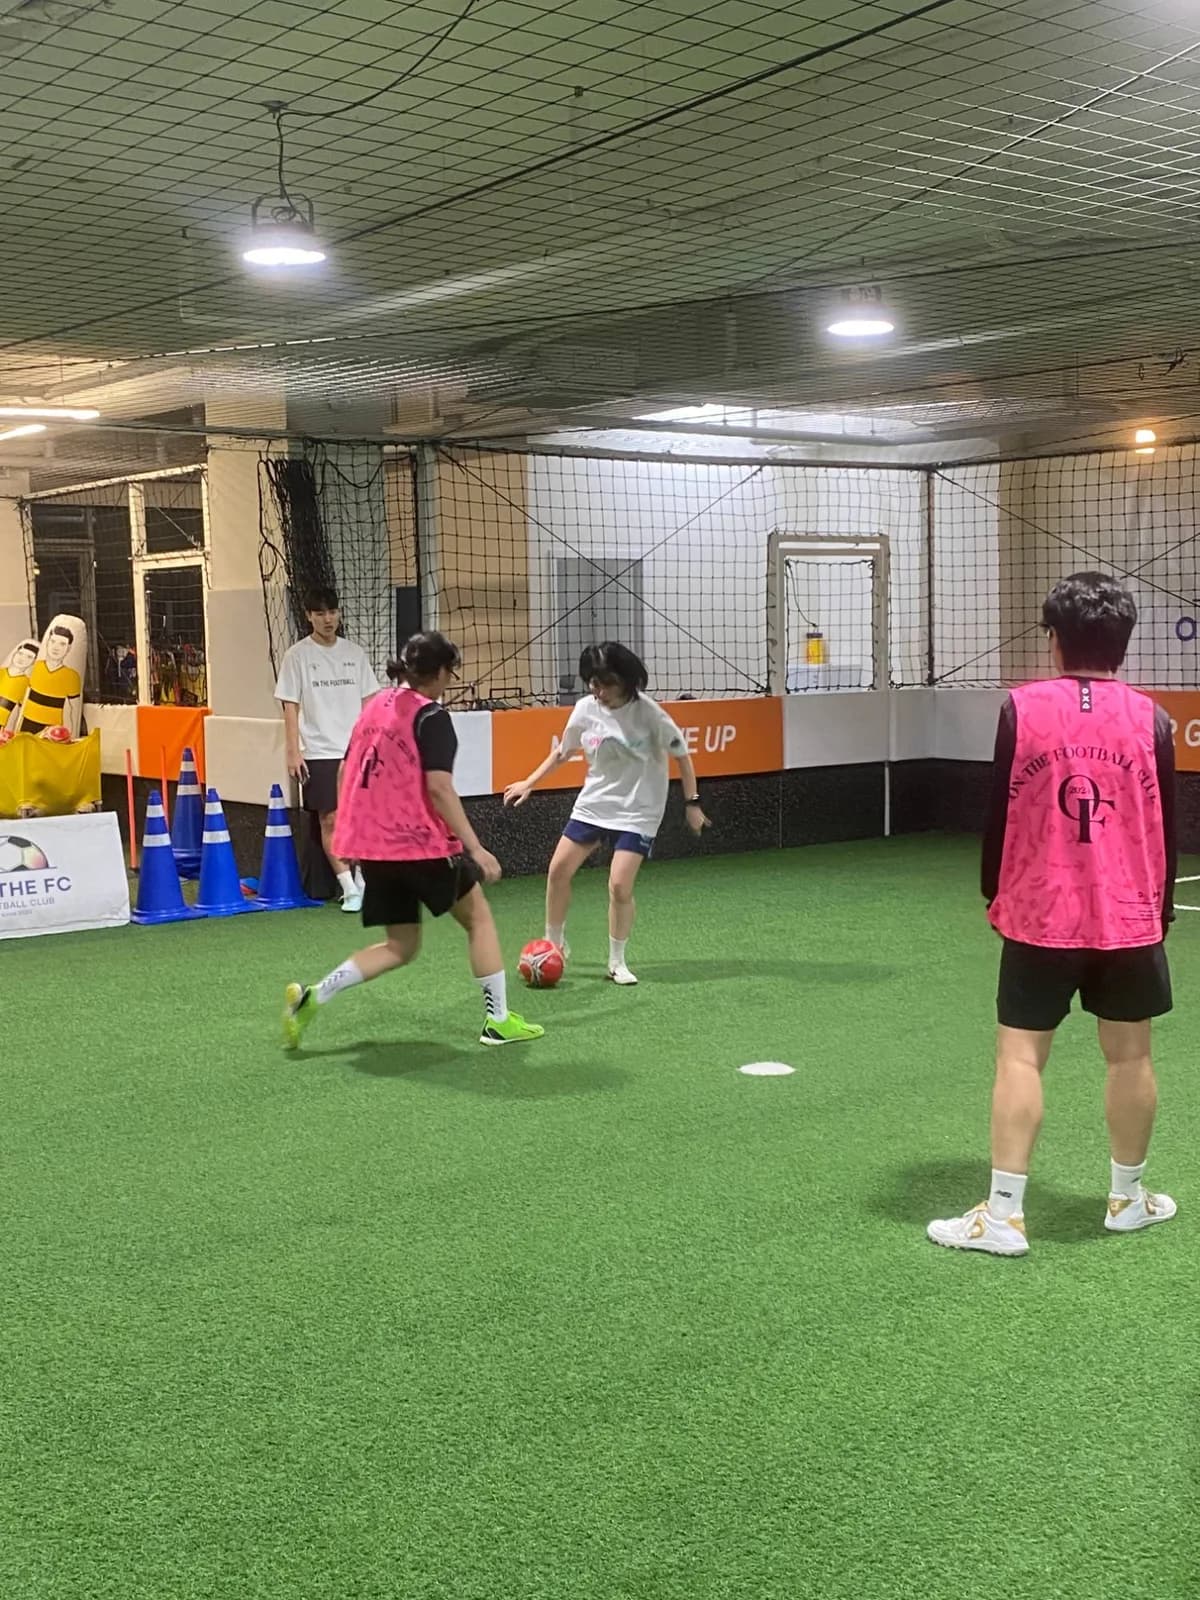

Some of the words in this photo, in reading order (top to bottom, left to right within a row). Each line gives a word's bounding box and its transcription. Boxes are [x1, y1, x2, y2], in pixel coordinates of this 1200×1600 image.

[705, 724, 737, 753] UP
[1022, 752, 1051, 777] THE
[1053, 745, 1135, 774] FOOTBALL
[0, 879, 38, 898] THE
[43, 876, 73, 893] FC
[30, 897, 55, 907] CLUB
